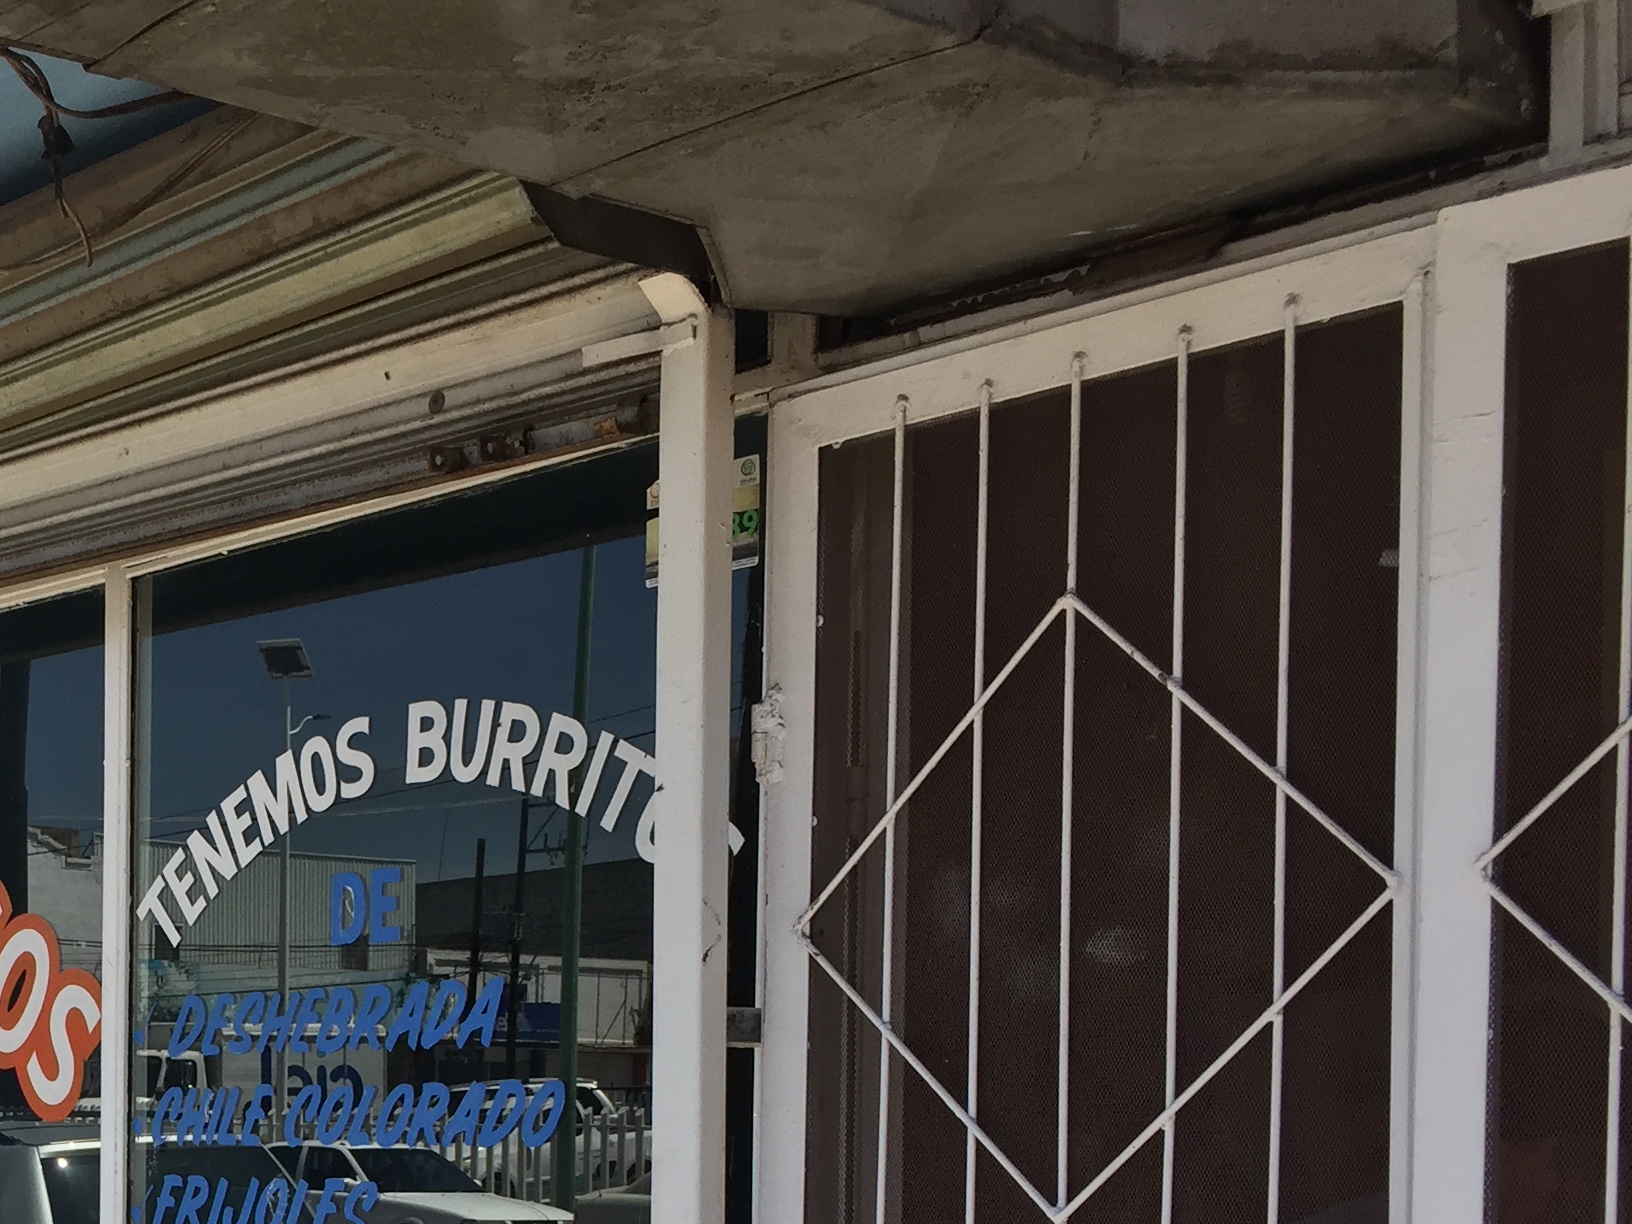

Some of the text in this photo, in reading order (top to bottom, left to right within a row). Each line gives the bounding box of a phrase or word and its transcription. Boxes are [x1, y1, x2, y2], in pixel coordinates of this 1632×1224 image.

[136, 716, 377, 948] TENEMOS
[405, 699, 745, 864] BURRIT
[330, 868, 403, 946] DE
[168, 976, 505, 1057] DESHEBRADA
[152, 1080, 566, 1148] CHILE COLORADO
